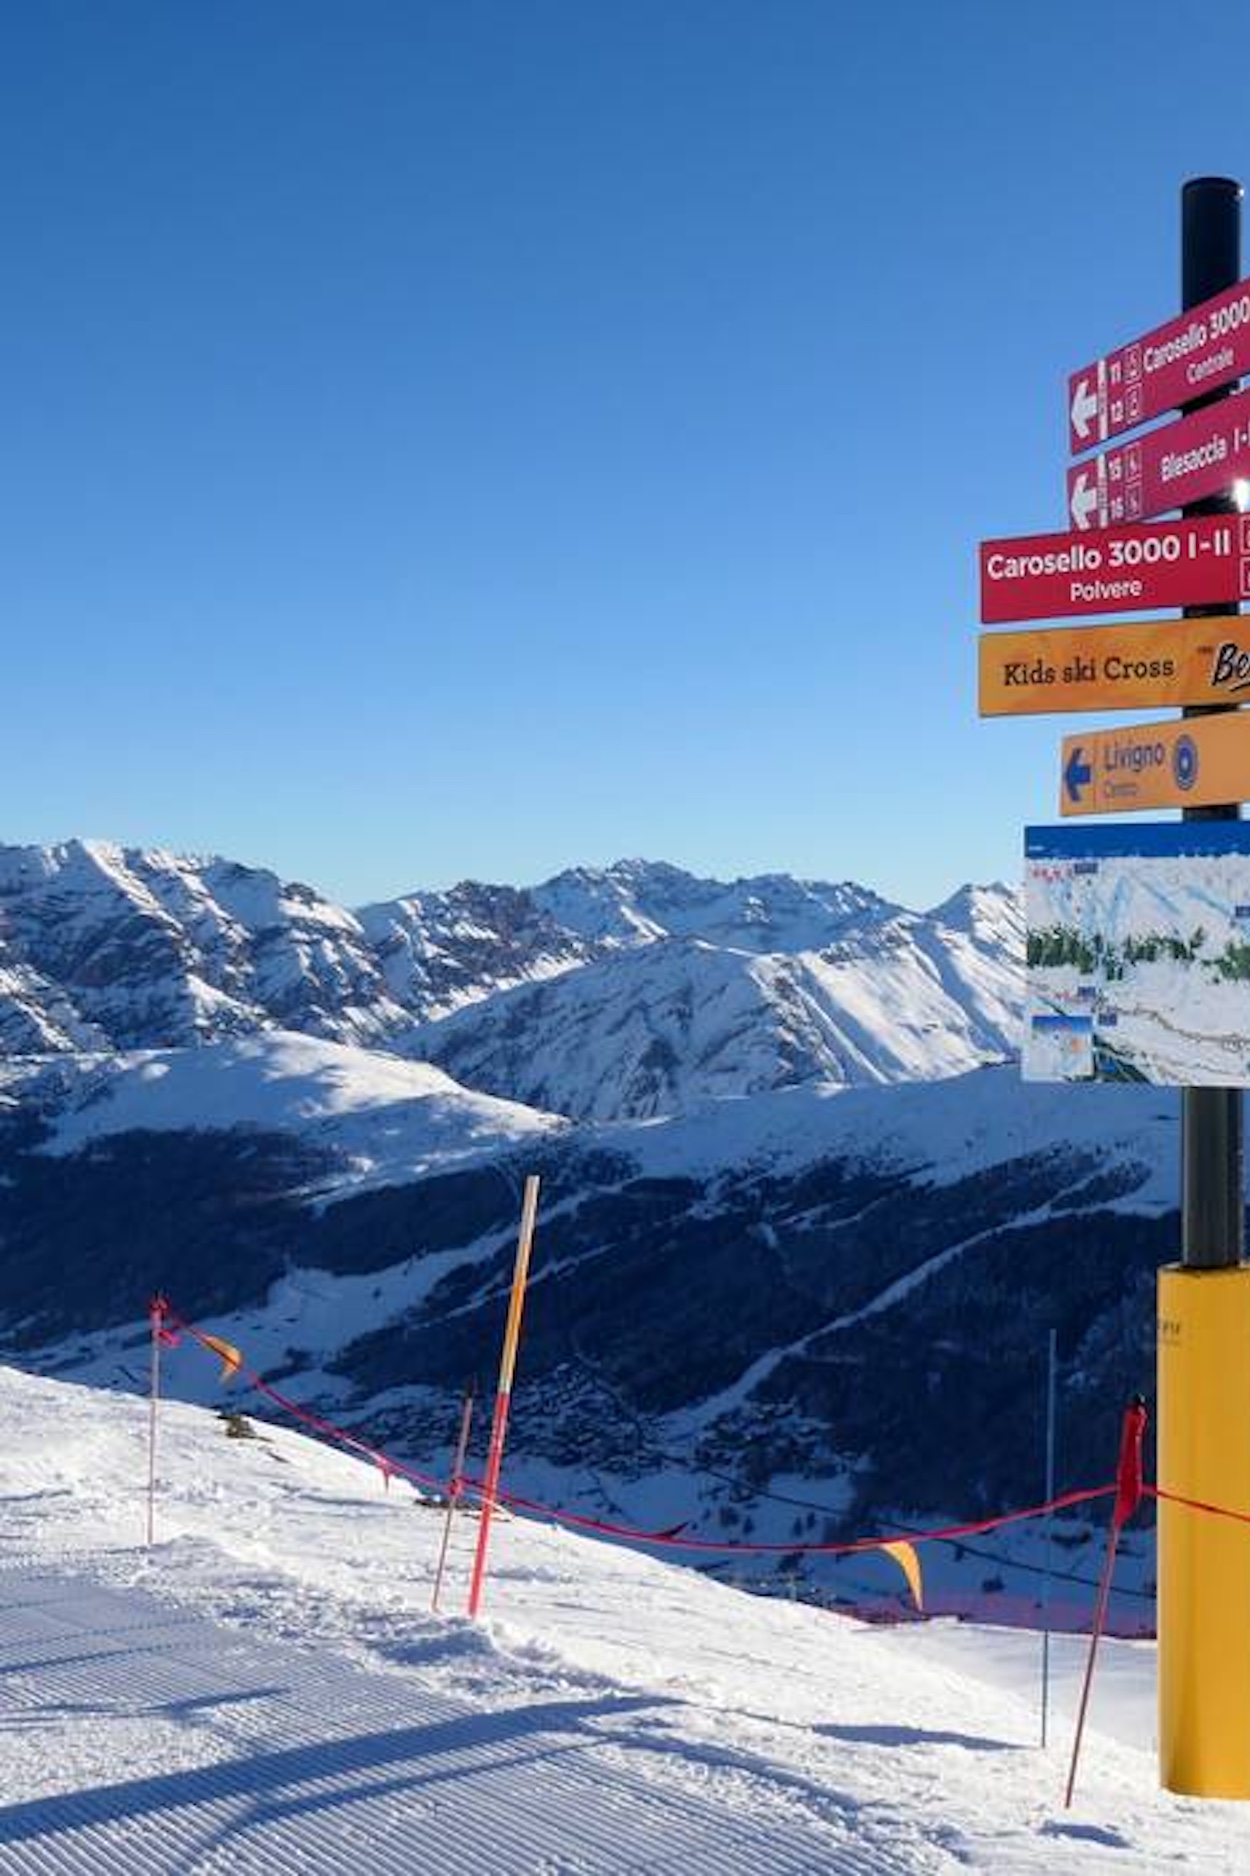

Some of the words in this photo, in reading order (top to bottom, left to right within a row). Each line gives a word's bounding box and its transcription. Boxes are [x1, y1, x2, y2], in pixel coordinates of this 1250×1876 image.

[1143, 322, 1208, 372] Carosello
[1160, 433, 1228, 482] Blesaccia
[987, 544, 1102, 580] Carosello
[1108, 534, 1181, 567] 3000
[1188, 529, 1231, 559] I-II
[1070, 579, 1143, 602] Polvere
[1004, 658, 1056, 686] Kids
[1063, 656, 1097, 684] ski
[1104, 656, 1175, 681] Cross
[1104, 740, 1165, 772] Livigno
